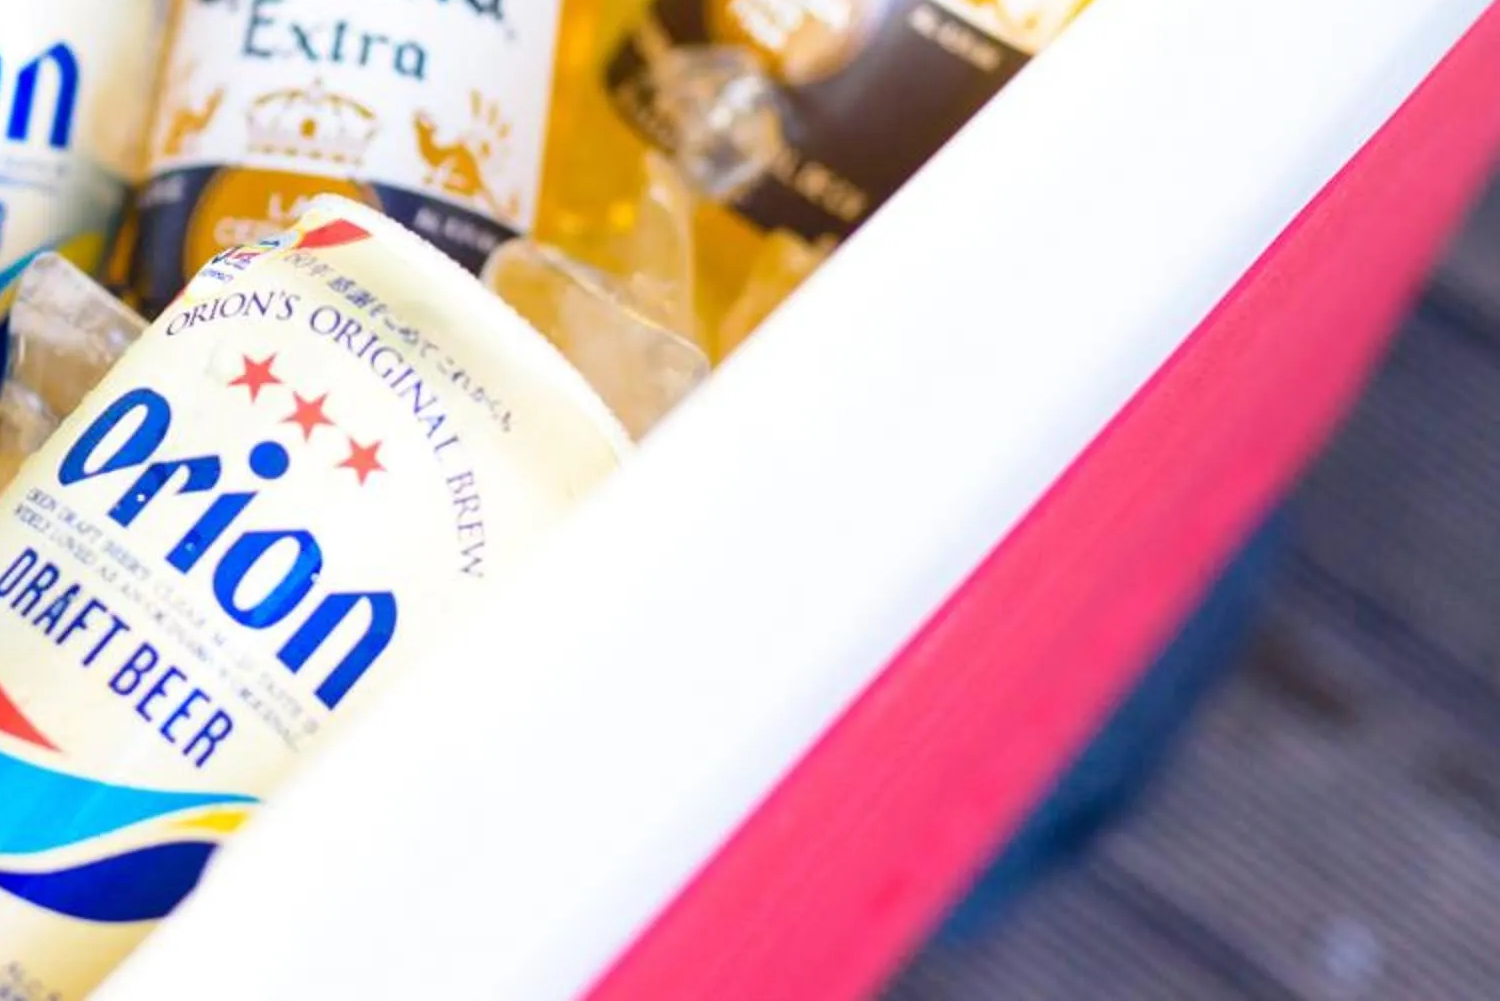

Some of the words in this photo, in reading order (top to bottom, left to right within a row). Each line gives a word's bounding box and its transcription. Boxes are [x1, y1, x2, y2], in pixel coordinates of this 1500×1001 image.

[165, 289, 301, 337] ORION'S
[308, 305, 460, 464] ORIGINAL
[445, 469, 485, 580] BREW
[107, 640, 235, 769] BEER
